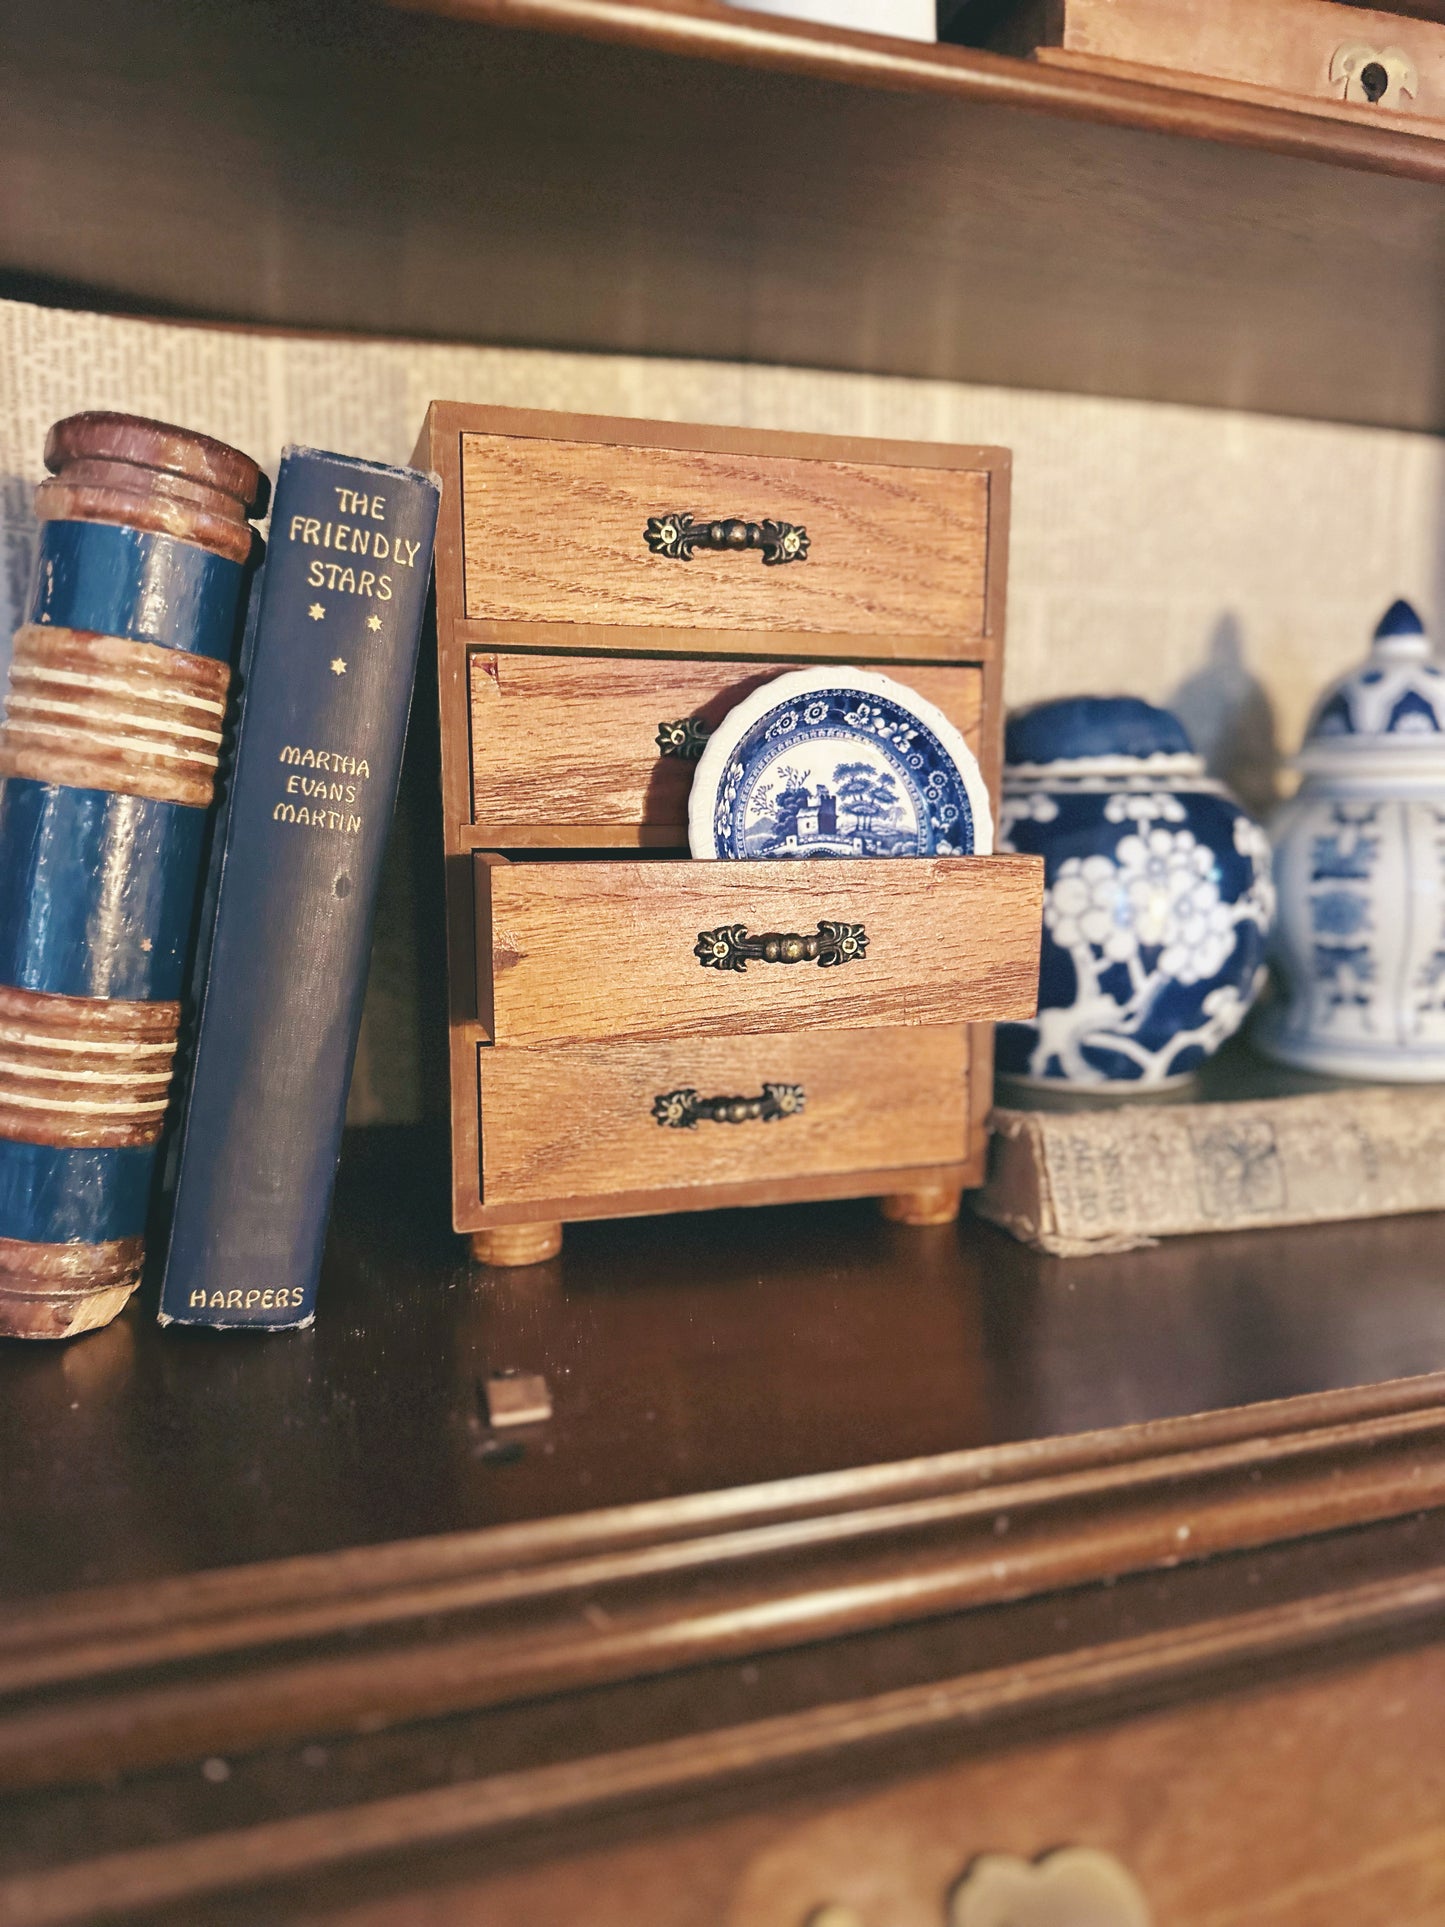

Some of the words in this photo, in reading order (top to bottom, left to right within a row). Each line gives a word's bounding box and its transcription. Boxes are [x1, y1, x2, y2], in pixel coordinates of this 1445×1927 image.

[335, 487, 386, 520] THE
[289, 516, 421, 567] FRIENDLY
[308, 560, 393, 600] STARS
[279, 745, 370, 779] MARTHA
[286, 775, 356, 803] EVANS
[273, 802, 361, 832] MARTIN
[189, 1286, 305, 1309] HARPERS
